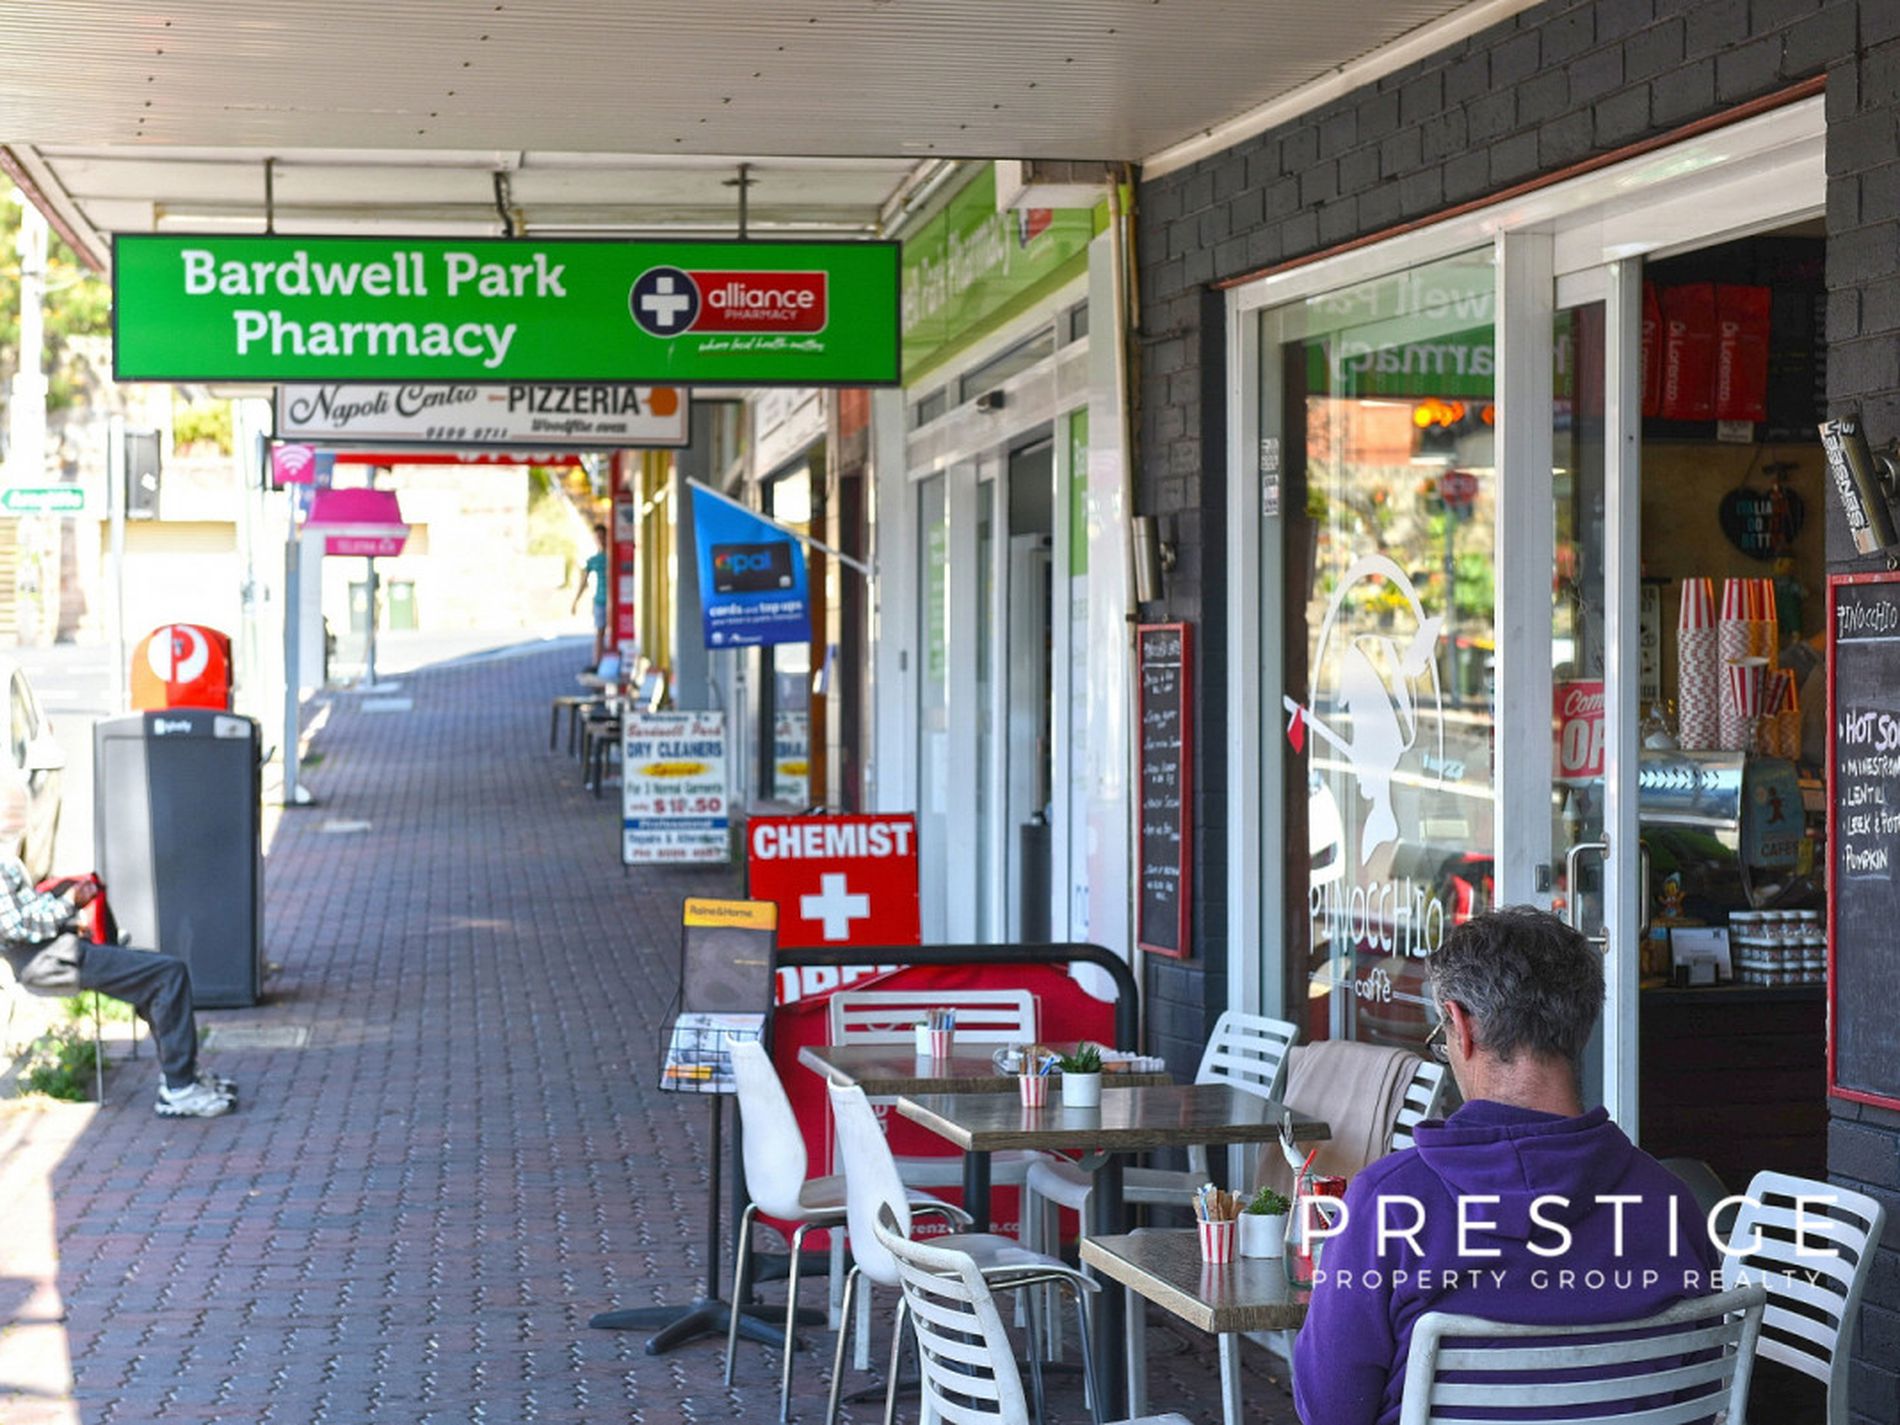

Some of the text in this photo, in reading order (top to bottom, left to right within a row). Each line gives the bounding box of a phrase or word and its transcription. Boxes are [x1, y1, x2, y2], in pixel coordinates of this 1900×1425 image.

[181, 249, 567, 297] Bardwell Park
[708, 282, 815, 309] alliance
[723, 309, 797, 321] PHARMACY
[232, 309, 517, 369] Pharmacy
[289, 384, 478, 428] Napoli Centro
[507, 386, 641, 416] PIZZERIA
[715, 551, 772, 577] opal
[1565, 689, 1605, 717] Com
[1846, 709, 1877, 745] HOT
[627, 741, 722, 758] DRY CLEANERS
[1562, 718, 1605, 770] OP
[1847, 813, 1870, 836] LEEK
[753, 822, 913, 860] CHEMIST
[1845, 844, 1888, 873] PUMPKIN
[1309, 876, 1443, 959] PINOCCHIO
